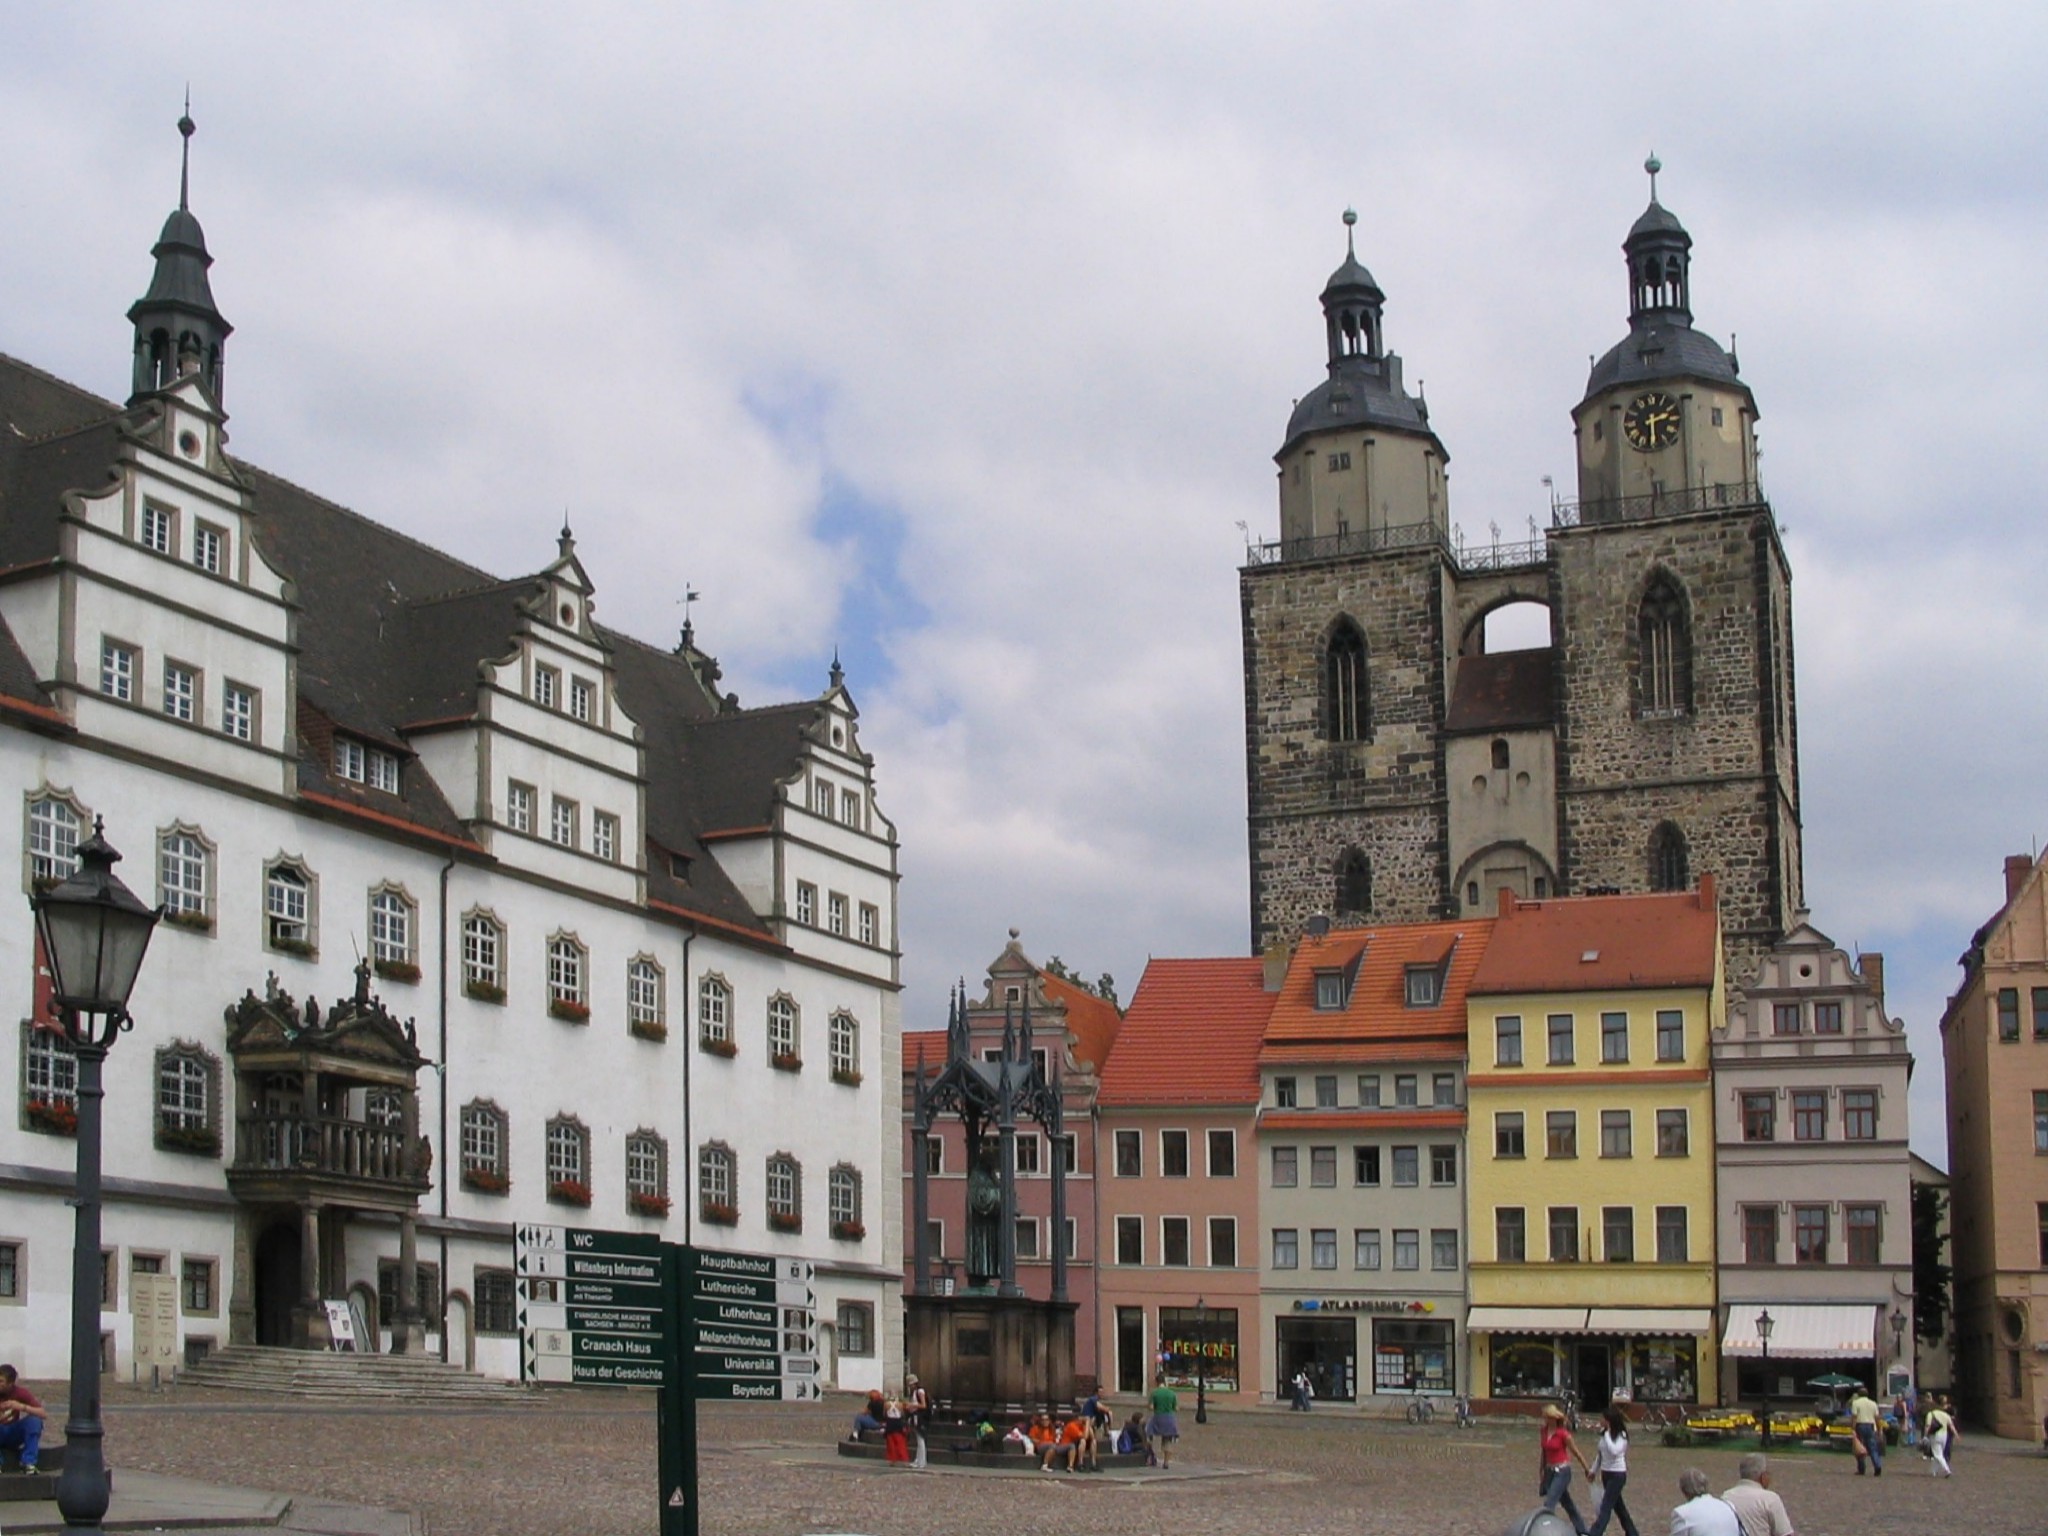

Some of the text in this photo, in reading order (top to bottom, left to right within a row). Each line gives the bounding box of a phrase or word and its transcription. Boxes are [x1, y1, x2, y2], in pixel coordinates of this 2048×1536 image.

[573, 1233, 593, 1247] WC
[614, 1262, 655, 1277] Information
[701, 1254, 770, 1273] Hauptbahnhof
[701, 1279, 757, 1296] Luthereiche
[720, 1305, 772, 1322] Lutherhaus
[1321, 1300, 1360, 1311] ATLAS
[581, 1338, 652, 1354] Cranach Haus
[700, 1330, 771, 1348] Melanchthonhaus
[724, 1357, 775, 1370] Universität
[574, 1364, 663, 1380] Haus der Geschichte
[732, 1384, 775, 1398] Beyerhof
